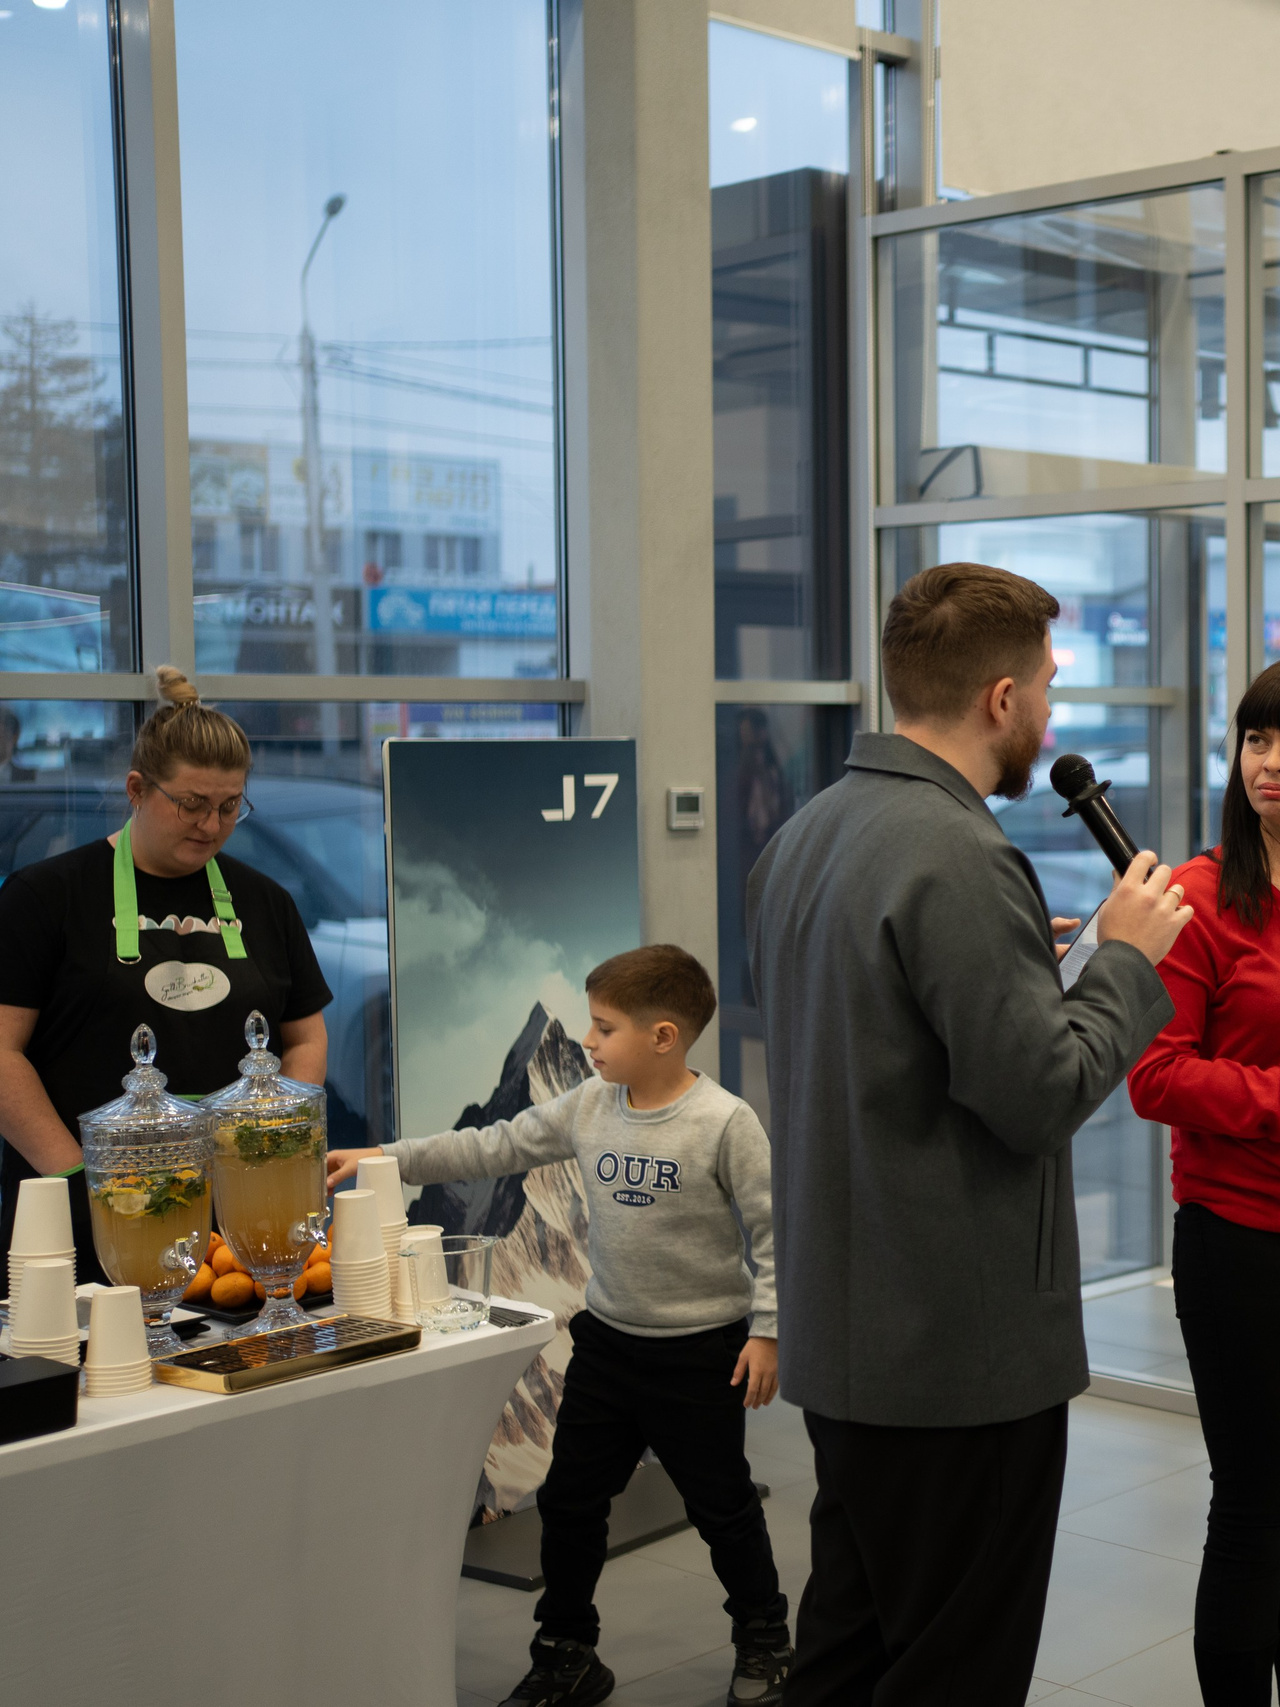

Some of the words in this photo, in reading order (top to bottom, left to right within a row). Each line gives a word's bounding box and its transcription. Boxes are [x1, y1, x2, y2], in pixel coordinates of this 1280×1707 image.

[541, 773, 619, 822] J7
[595, 1150, 681, 1191] OUR
[616, 1192, 652, 1204] EST.2016
